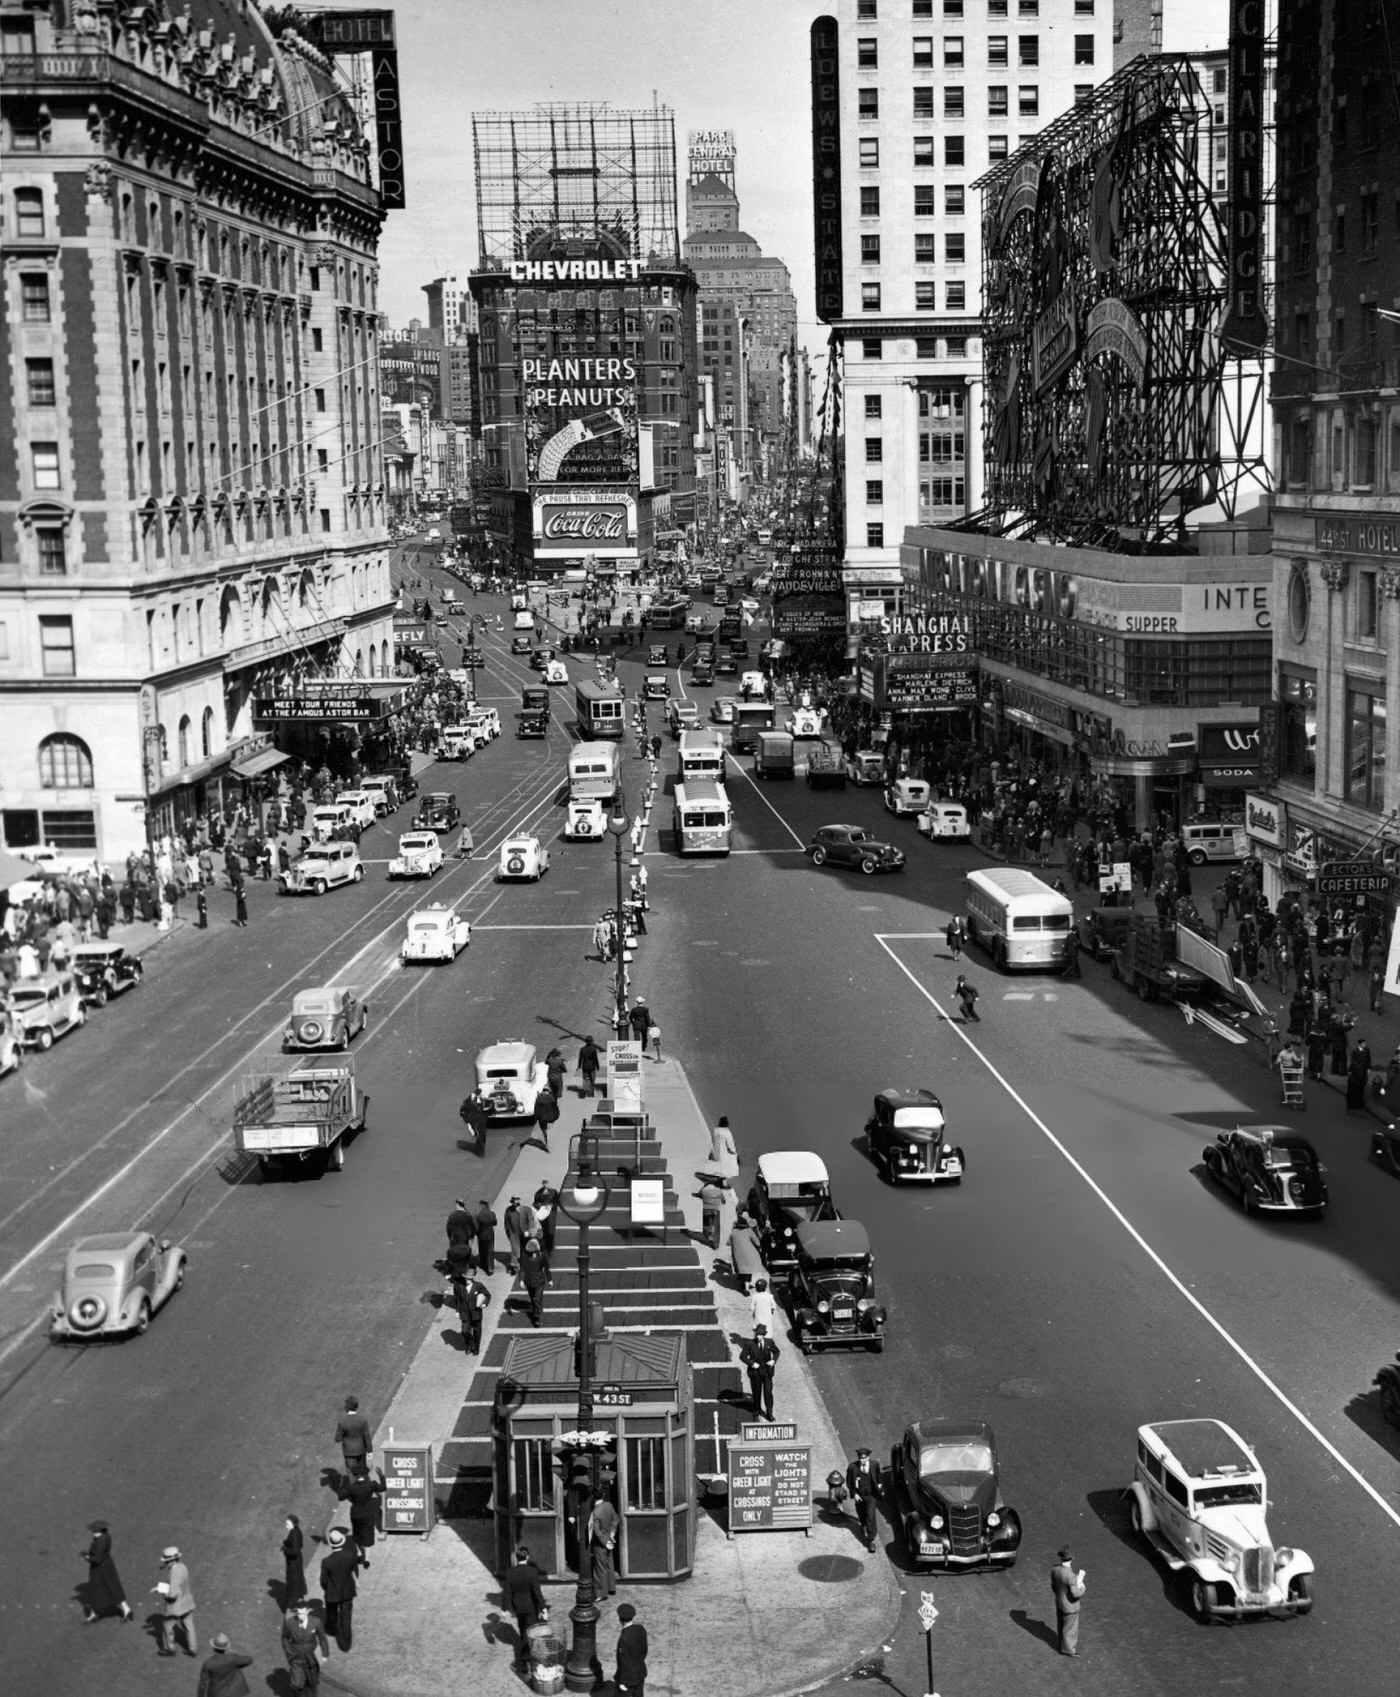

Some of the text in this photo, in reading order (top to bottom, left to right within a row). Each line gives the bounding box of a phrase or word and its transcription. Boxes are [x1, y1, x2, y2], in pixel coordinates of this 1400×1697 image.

[323, 19, 392, 42] HOTEL
[375, 58, 402, 201] ASTOR
[696, 131, 727, 143] PARK
[688, 146, 736, 157] CENTRAL
[692, 161, 731, 171] HOTEL
[1237, 2, 1256, 318] CLARIDGE
[820, 193, 840, 310] STATE
[511, 261, 640, 280] CHEVROLET
[523, 358, 635, 381] PLANTERS
[535, 387, 626, 406] PEANUTS
[534, 494, 633, 507] THE PAUSE THAT REFRESHES
[545, 511, 625, 538] Coca-Cola
[1360, 526, 1398, 552] HOTEL
[773, 581, 837, 592] VAUDEVILLE
[1204, 587, 1267, 610] INTE
[881, 616, 969, 634] SHANGHAI
[1126, 616, 1178, 632] SUPPER
[263, 709, 272, 717] AT
[1213, 769, 1253, 777] SODA
[1320, 876, 1389, 892] CAFETERIA
[603, 1394, 617, 1404] 43
[618, 1394, 631, 1404] ST
[745, 1426, 794, 1440] INFORMATION
[392, 1457, 418, 1469] CROSS
[739, 1456, 765, 1468] CROSS
[775, 1453, 808, 1461] WATCH
[774, 1469, 808, 1477] LIGHTS
[732, 1475, 772, 1488] GREEN LIGHT
[733, 1496, 771, 1508] CROSSINGS
[778, 1496, 805, 1505] STREET
[742, 1510, 763, 1522] ONLY
